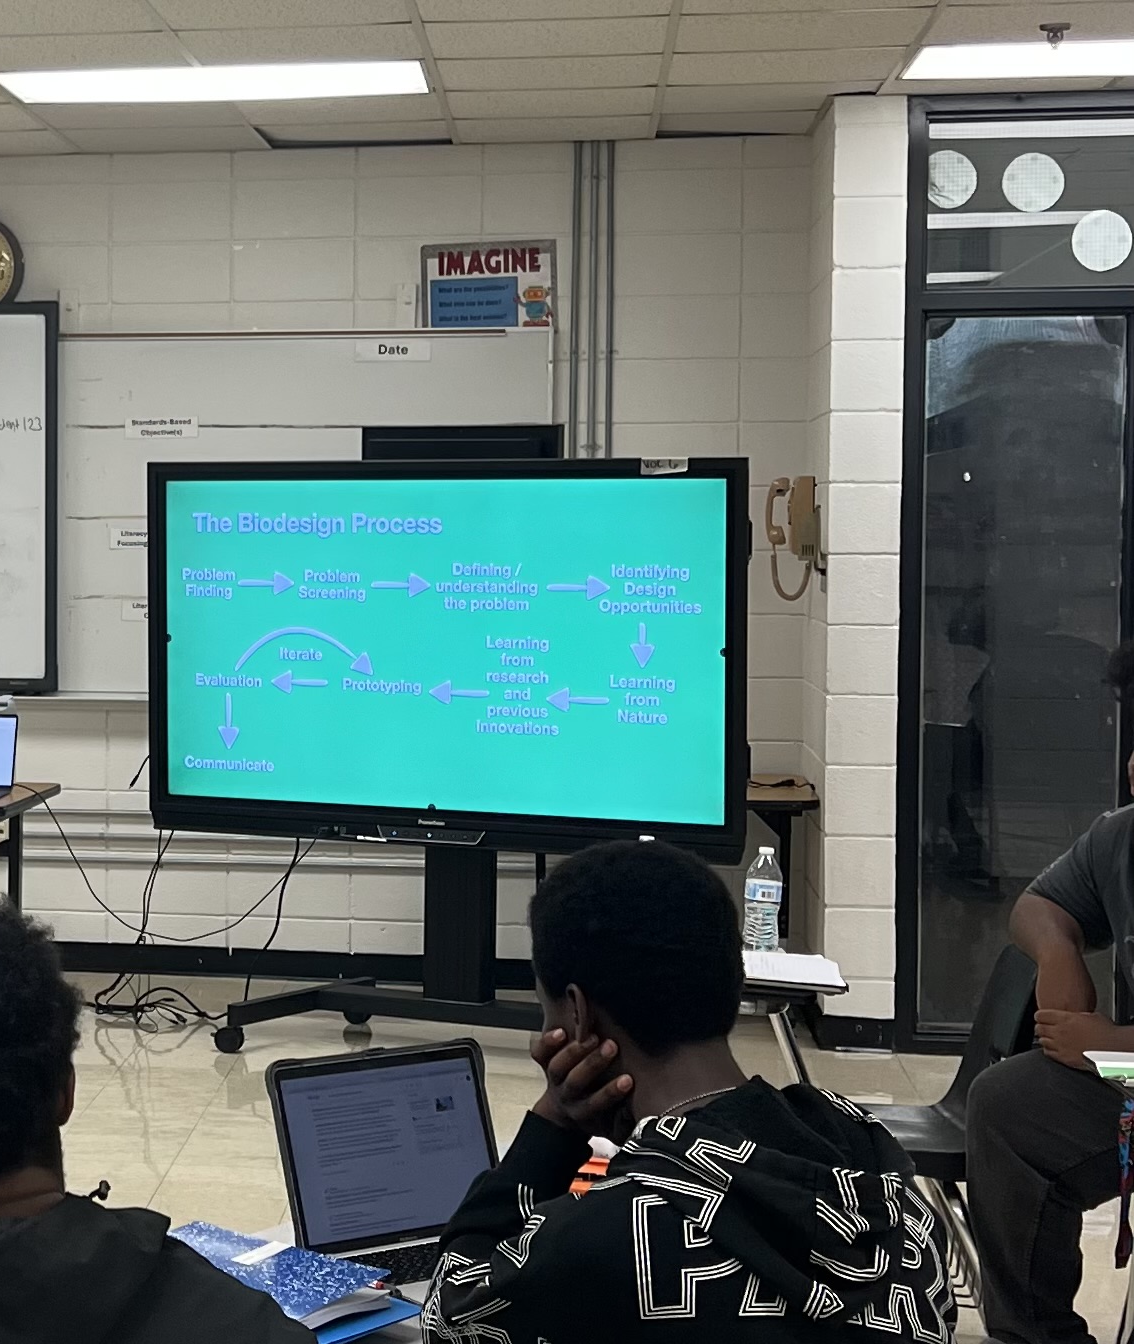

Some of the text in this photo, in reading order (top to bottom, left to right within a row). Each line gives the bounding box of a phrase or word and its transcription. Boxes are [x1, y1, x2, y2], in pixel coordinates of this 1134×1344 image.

[438, 247, 541, 276] IMAGINE
[378, 343, 409, 355] Date
[192, 512, 443, 539] The Biodesign Process
[182, 567, 236, 582] Problem
[304, 568, 361, 583] Problem
[452, 562, 522, 578] Defining /
[611, 564, 691, 581] Identifying
[185, 584, 233, 600] Finding
[298, 586, 366, 603] Screening
[435, 580, 539, 597] understanding
[624, 582, 677, 598] Design
[444, 597, 530, 613] the problem
[599, 599, 703, 615] Opportunities
[485, 635, 550, 653] Learning
[279, 647, 323, 661] Iterate
[500, 652, 535, 667] from
[195, 673, 263, 688] Evaluation
[486, 671, 549, 685] research
[609, 674, 676, 693] Learning
[342, 677, 422, 696] Prototyping
[503, 687, 531, 701] and
[624, 692, 660, 707] from
[486, 704, 549, 719] previous
[617, 708, 668, 725] Nature
[183, 754, 275, 773] Communicate
